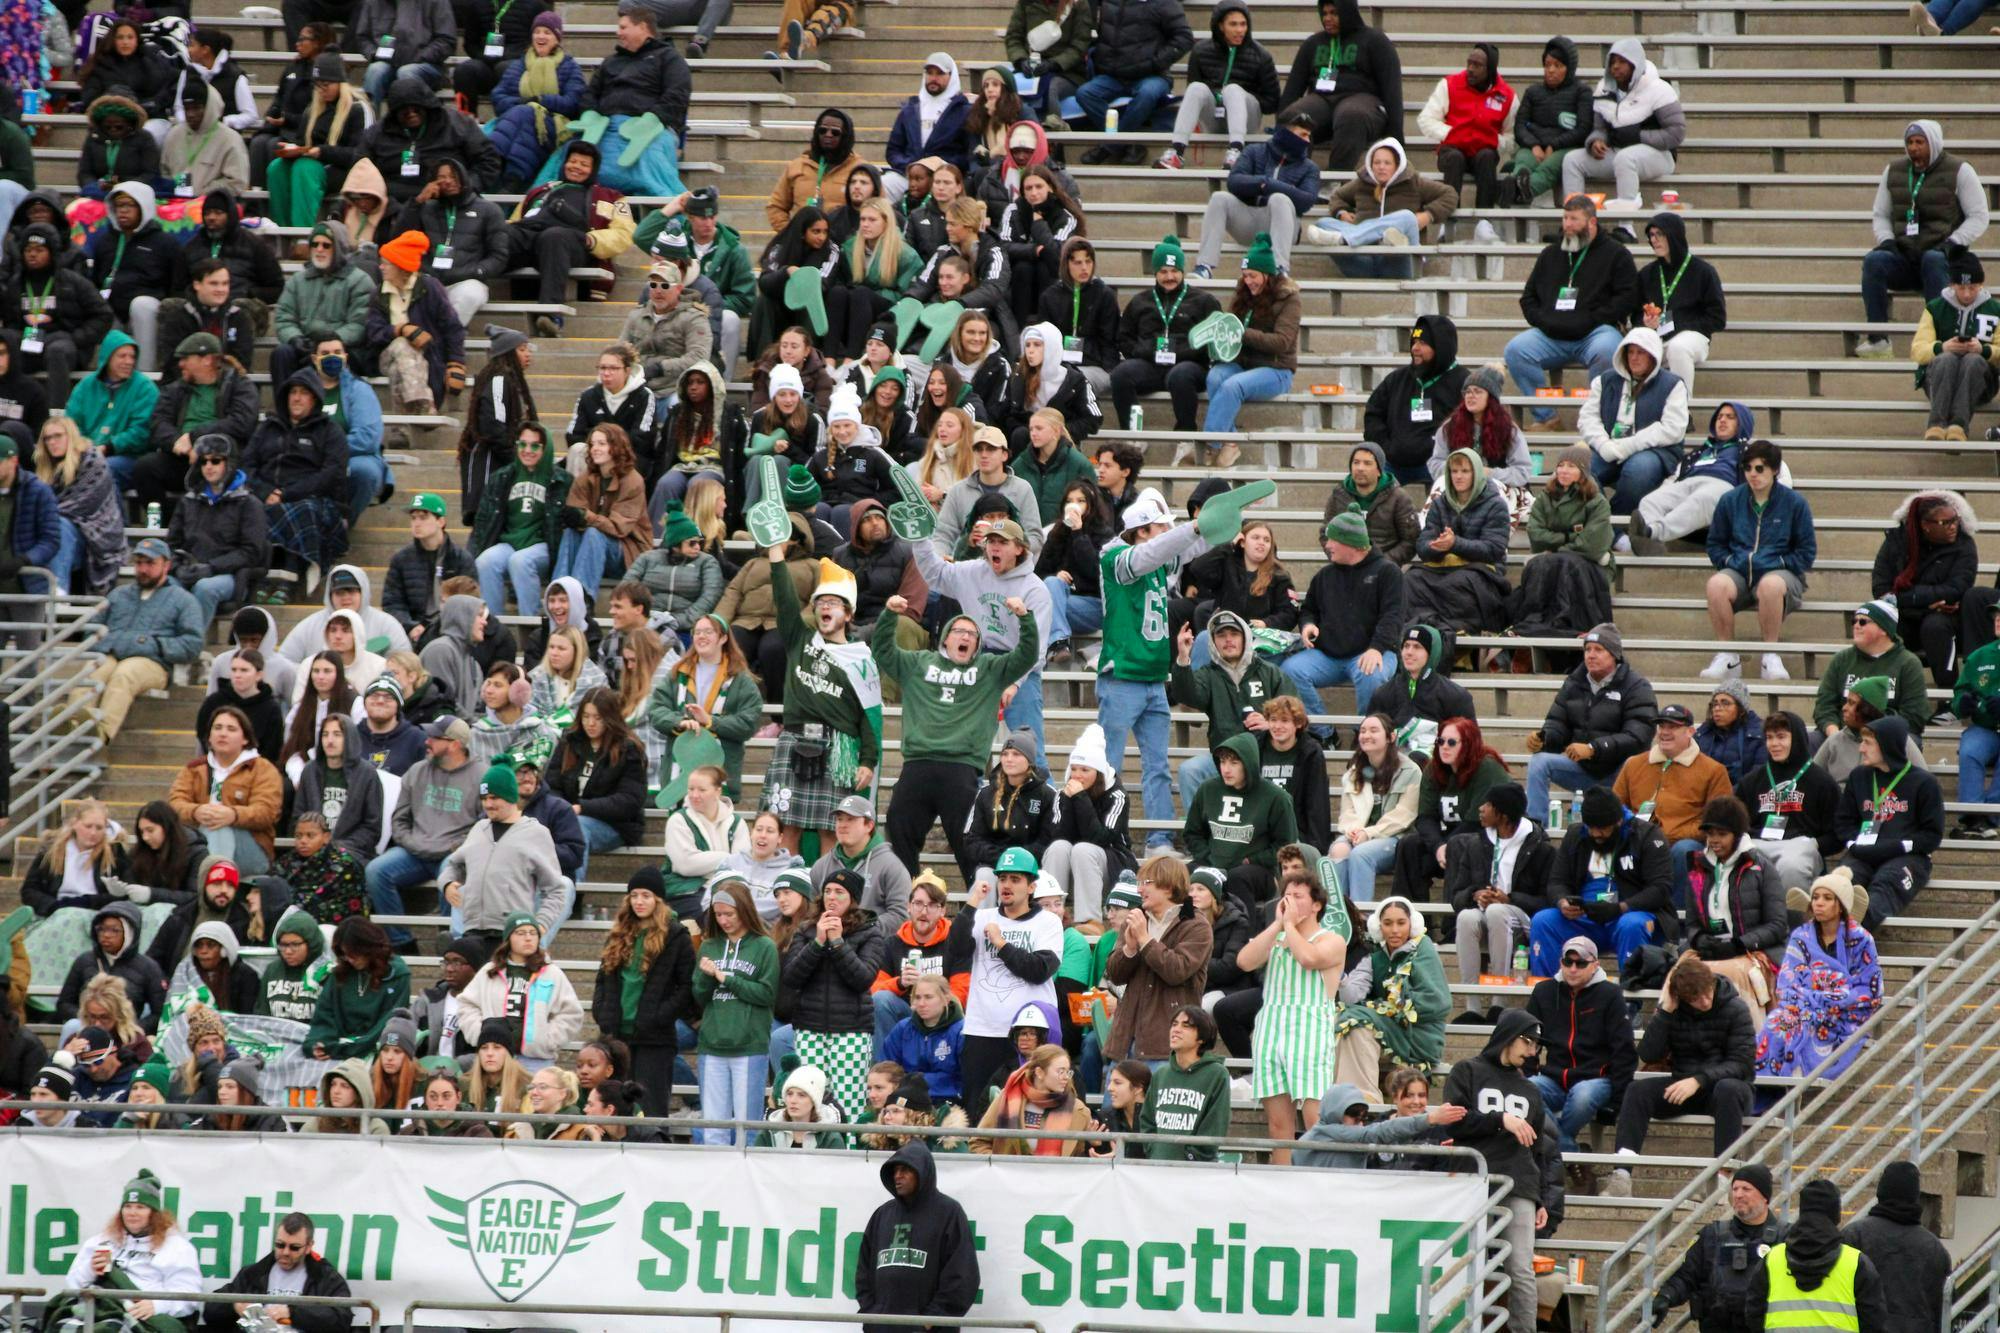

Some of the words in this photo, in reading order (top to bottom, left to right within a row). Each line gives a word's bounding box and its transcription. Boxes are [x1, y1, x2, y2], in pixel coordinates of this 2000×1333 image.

[1166, 254, 1176, 266] E
[1976, 313, 1999, 343] E
[412, 495, 424, 506] E
[520, 497, 533, 513] E
[767, 522, 785, 542] E
[903, 519, 921, 538] E
[988, 603, 1005, 620] E
[925, 664, 978, 686] EMU
[940, 687, 956, 703] E
[1248, 681, 1264, 697] E
[1029, 799, 1042, 814] E
[1219, 795, 1243, 822] E
[1440, 796, 1462, 822] E
[1003, 853, 1016, 866] E
[1619, 855, 1634, 870] W
[1001, 930, 1032, 943] STERN
[506, 994, 522, 1018] E
[1155, 1087, 1206, 1111] EASTERN
[1155, 1110, 1198, 1131] MICHIGAN
[128, 1191, 139, 1202] E
[479, 1198, 565, 1231] EAGLE
[476, 1230, 558, 1255] NATION
[889, 1223, 912, 1249] E
[497, 1257, 526, 1288] E
[1021, 1214, 1358, 1320] Section
